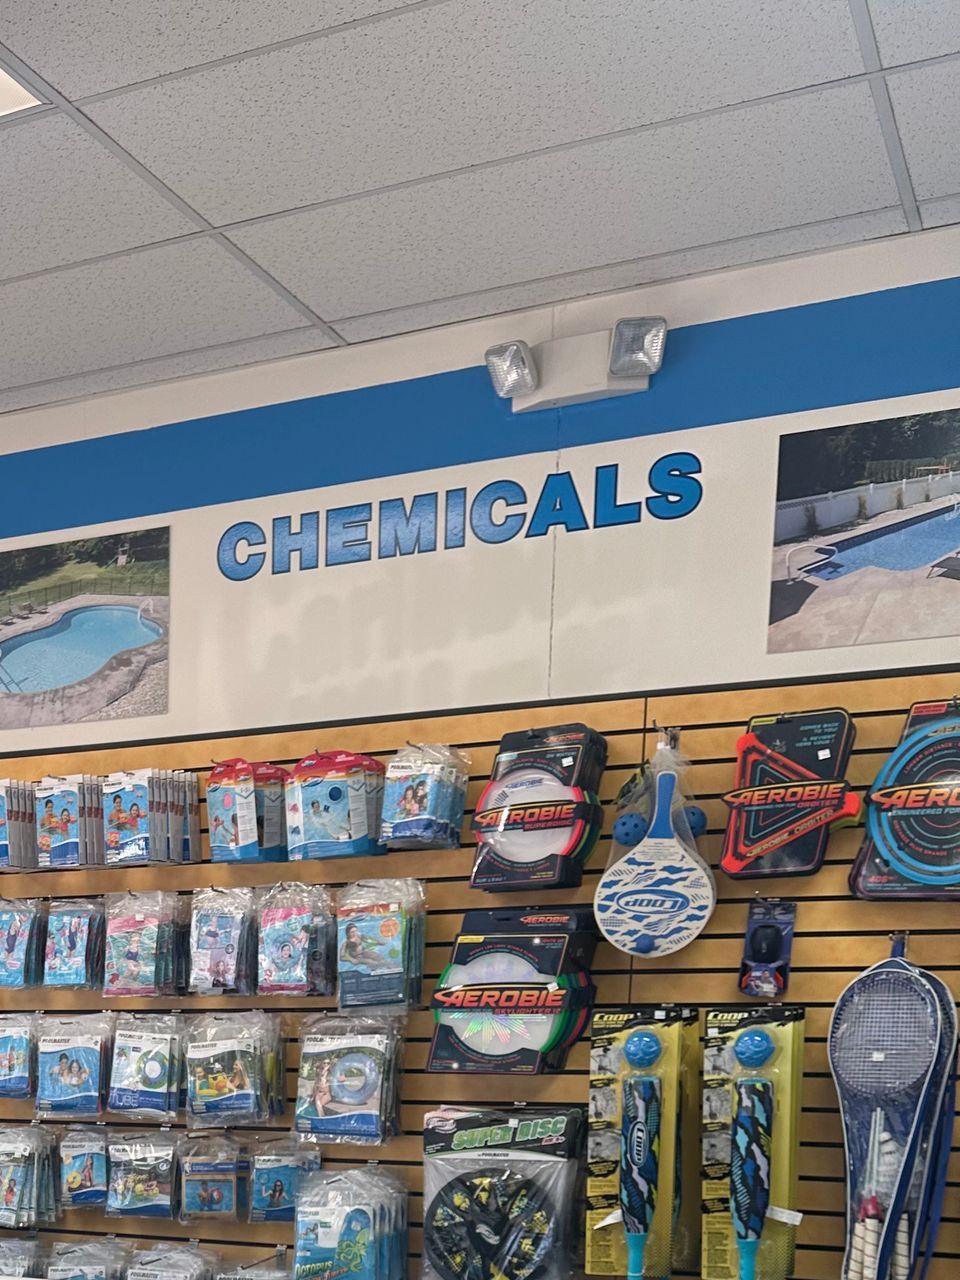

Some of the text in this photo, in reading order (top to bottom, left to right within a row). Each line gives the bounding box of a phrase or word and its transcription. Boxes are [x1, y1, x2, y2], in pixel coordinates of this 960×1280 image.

[216, 451, 704, 582] CHEMICALS
[723, 783, 846, 805] AEROBIE
[796, 800, 839, 808] ORBITER
[746, 809, 834, 857] AEROBIE ORBITER
[520, 914, 570, 924] AEROBIE
[434, 988, 567, 1007] AEROBIE
[451, 1116, 568, 1150] SUPER DISC
[295, 1260, 333, 1277] OCTOPUS
